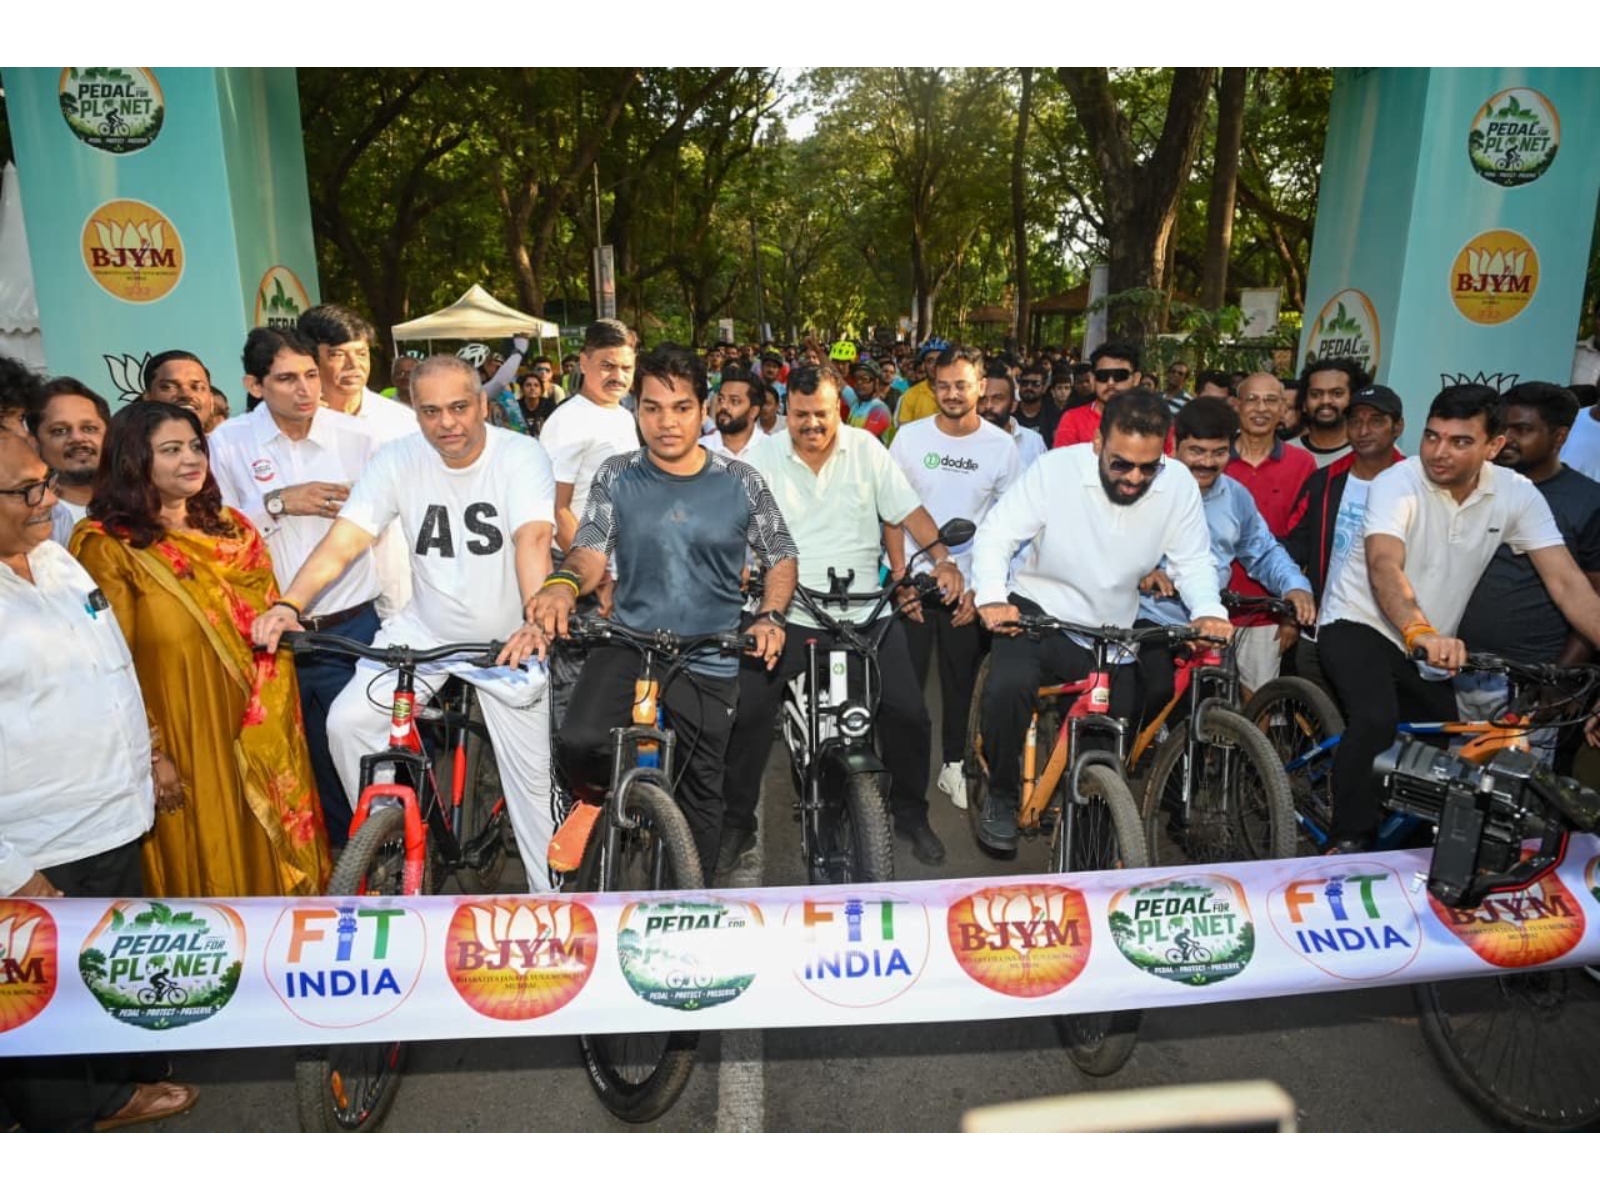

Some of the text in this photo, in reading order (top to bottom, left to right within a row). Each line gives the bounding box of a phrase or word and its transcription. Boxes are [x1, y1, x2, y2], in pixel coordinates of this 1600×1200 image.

[79, 82, 134, 99] PEDAL
[1487, 121, 1538, 137] PEDAL
[90, 247, 176, 267] BJYM
[1456, 273, 1531, 292] BJYM
[268, 317, 299, 329] PEDA
[1319, 337, 1359, 357] PEDAL
[941, 454, 978, 471] doddle
[1134, 897, 1229, 920] PEDAL FOR
[1285, 874, 1389, 923] FIT
[287, 906, 406, 963] FIT
[958, 919, 1082, 951] BJYM
[1136, 914, 1236, 945] PLNET
[1296, 925, 1412, 953] INDIA
[109, 932, 226, 958] PEDAL FOR
[455, 937, 587, 970] BJYM
[109, 952, 227, 984] PLNET
[804, 948, 912, 979] INDIA
[286, 968, 401, 998] INDIA
